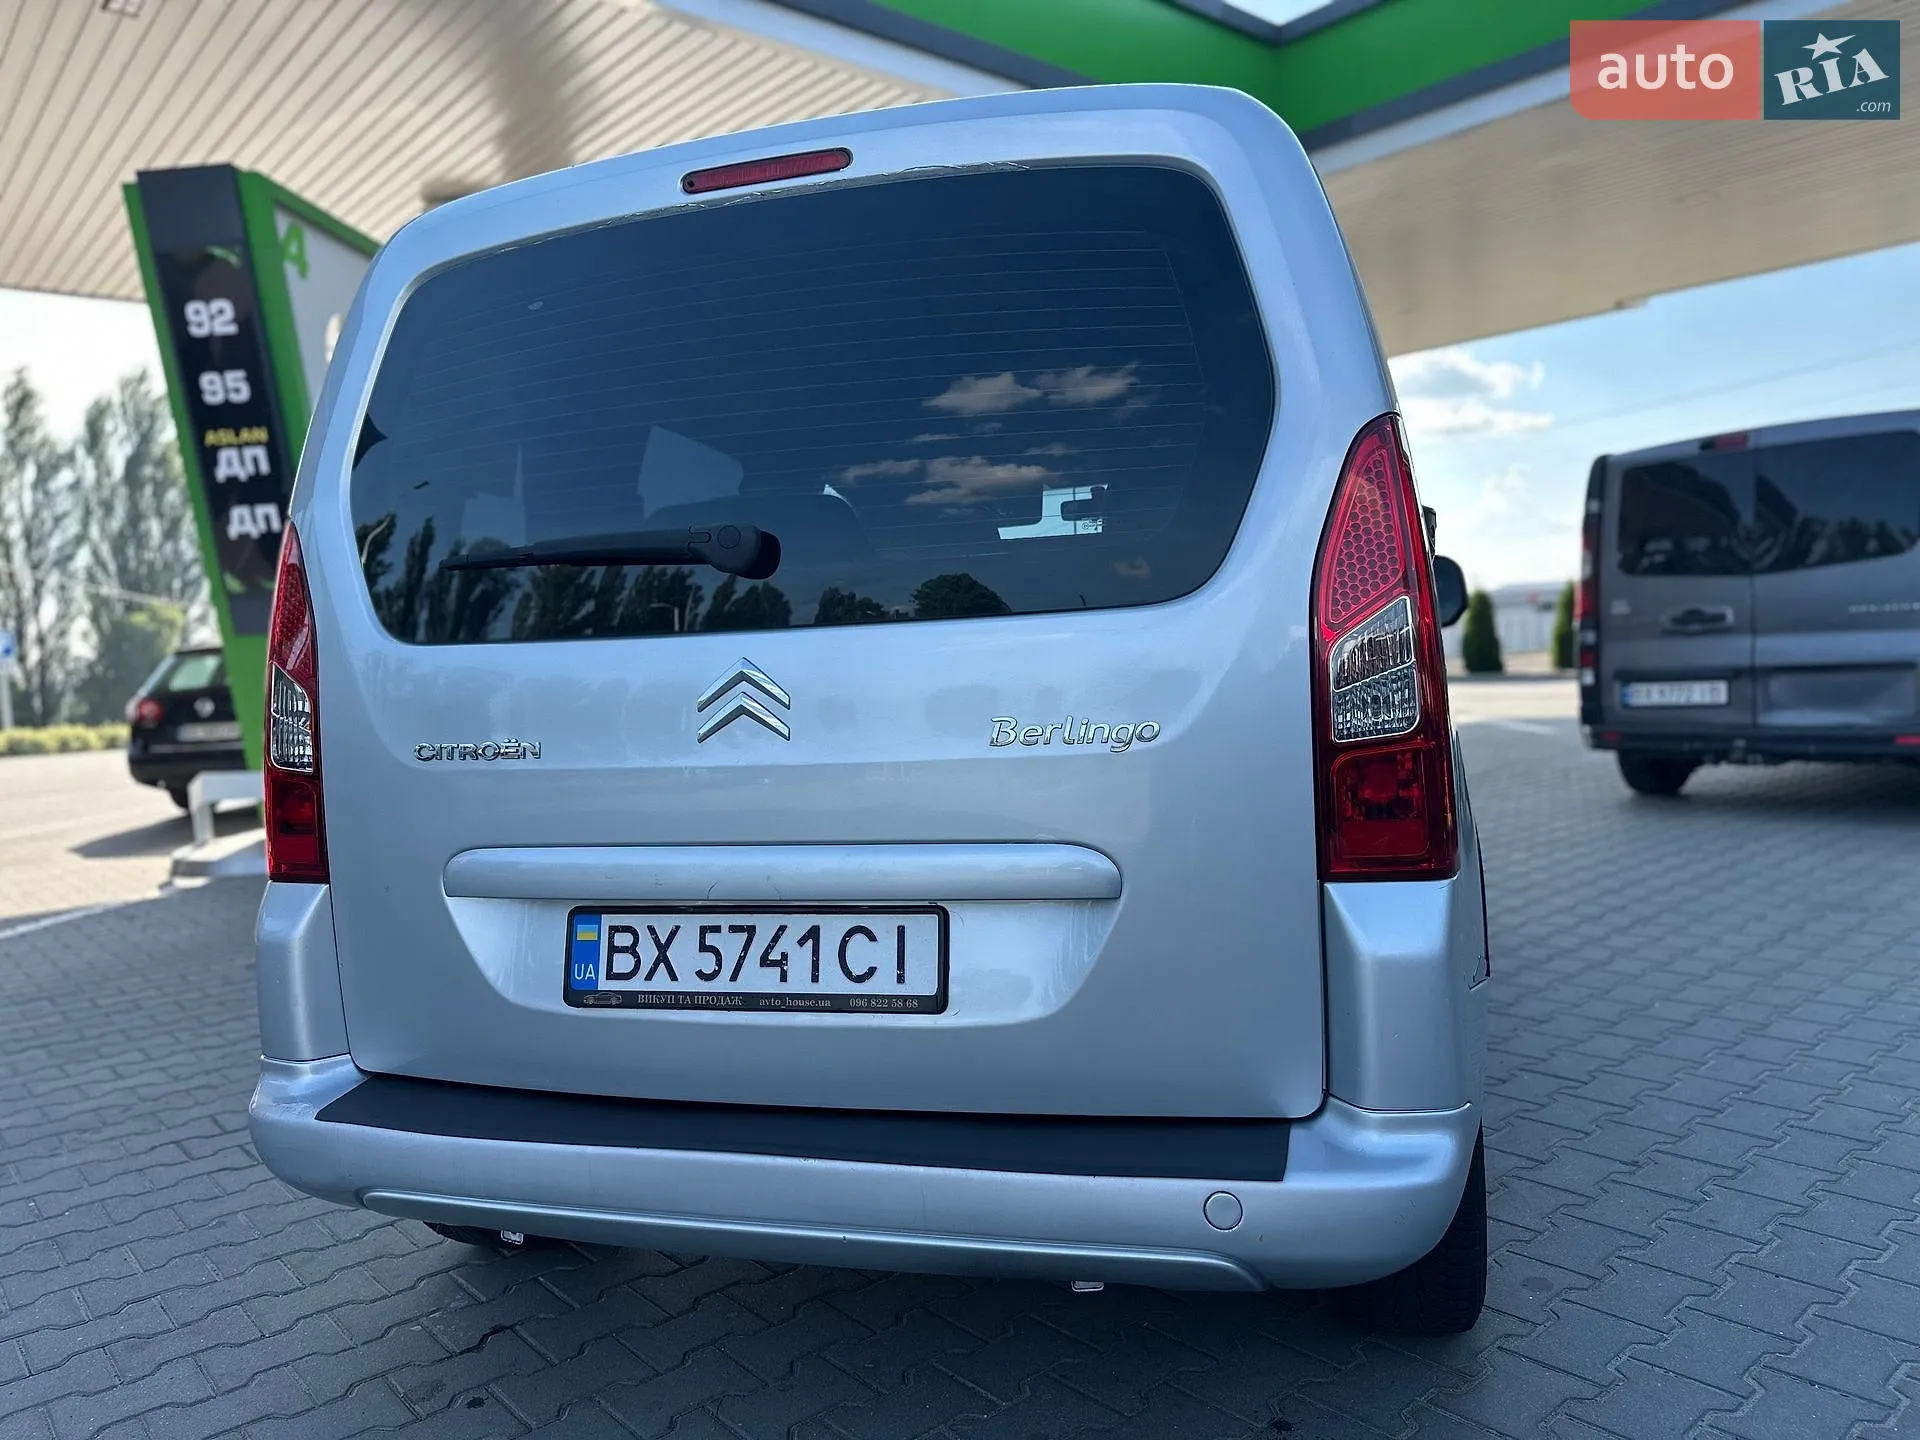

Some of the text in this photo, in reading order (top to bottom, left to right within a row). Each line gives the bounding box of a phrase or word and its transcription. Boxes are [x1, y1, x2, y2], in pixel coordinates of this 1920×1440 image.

[184, 299, 239, 338] 92
[199, 369, 251, 405] 95
[214, 445, 271, 483] ДП
[226, 503, 282, 541] ДП
[413, 738, 542, 762] CITROËN
[989, 715, 1161, 753] Berlingo
[574, 963, 596, 980] UA
[606, 925, 906, 984] BX 5741 CI
[637, 993, 743, 1007] ВИКУП ТА ПРОДАЖ
[759, 996, 831, 1009] avto_house.ua
[850, 998, 919, 1009] 096 822 58 68
